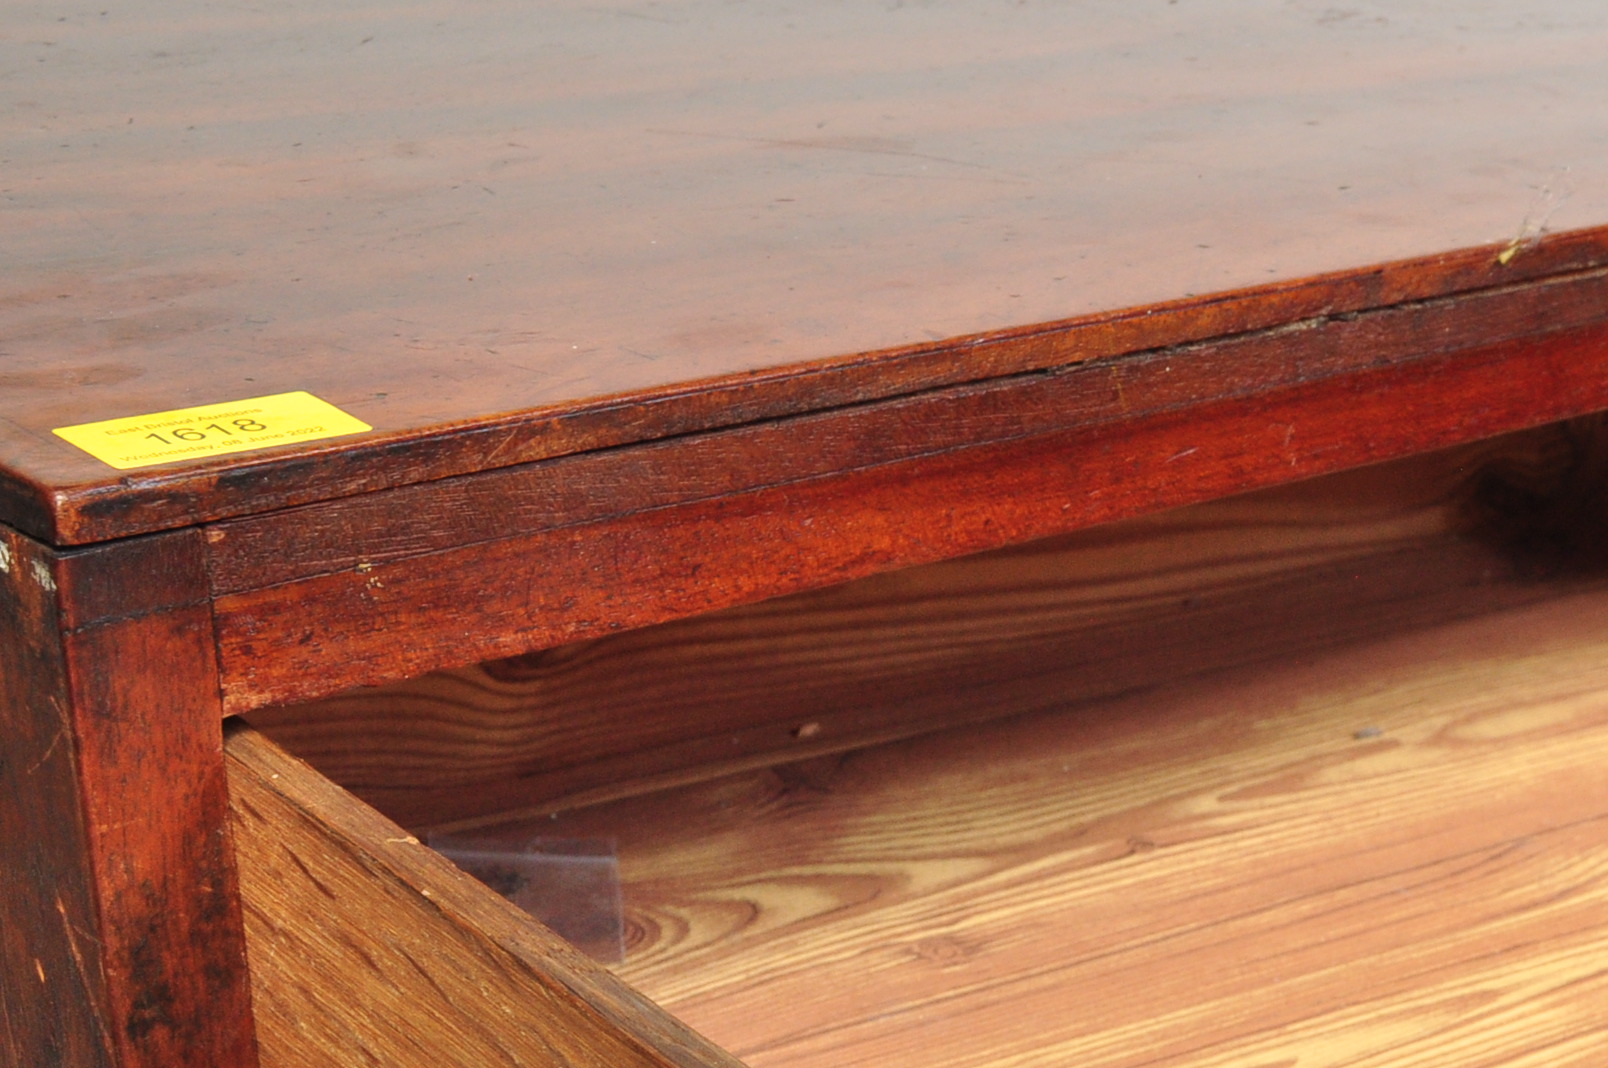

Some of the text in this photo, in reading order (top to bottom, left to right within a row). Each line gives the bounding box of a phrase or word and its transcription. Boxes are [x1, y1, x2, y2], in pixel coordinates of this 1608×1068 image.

[104, 408, 263, 436] East Bristol Auctions
[144, 418, 267, 445] 1618
[248, 433, 285, 443] June
[286, 425, 327, 436] 2022
